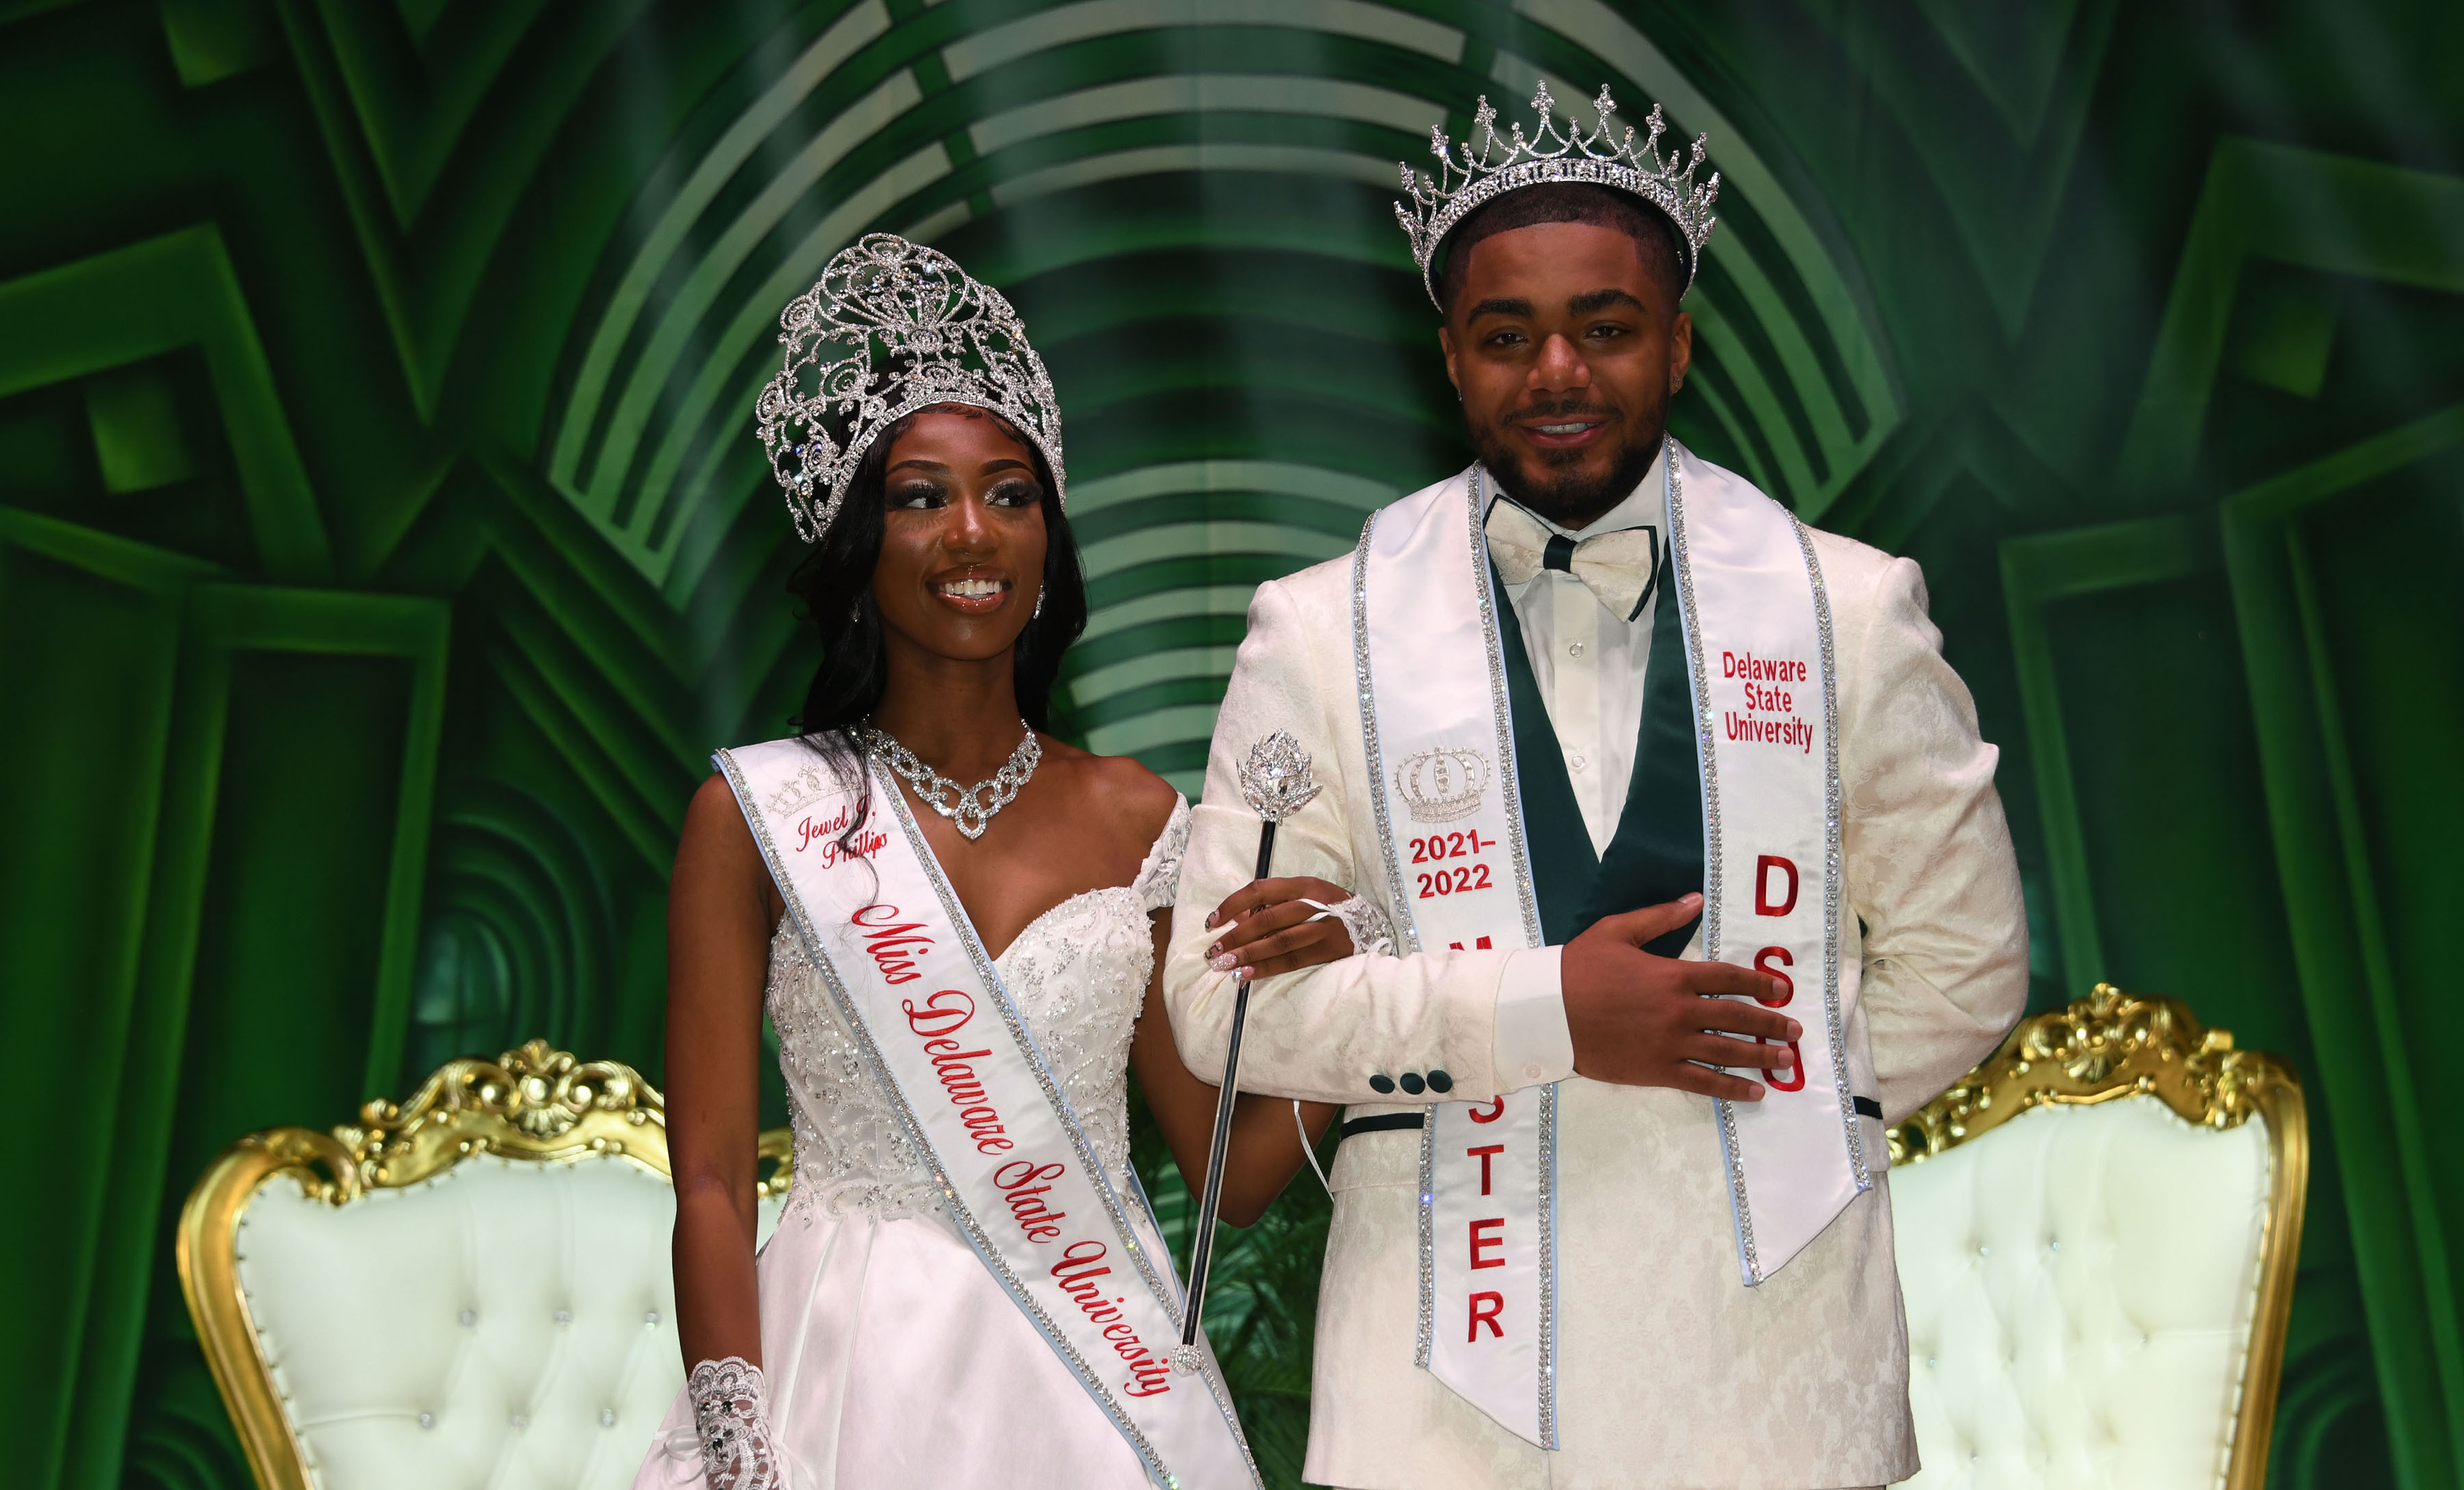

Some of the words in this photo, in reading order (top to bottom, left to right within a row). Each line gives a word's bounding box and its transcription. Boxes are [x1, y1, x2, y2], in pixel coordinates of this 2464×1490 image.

[1722, 650, 1807, 682] Delaware
[1745, 682, 1793, 713] State
[1725, 710, 1813, 754] University
[796, 805, 849, 852] Jewel
[1409, 829, 1496, 864] 2021-
[821, 830, 888, 869] Phillips
[1416, 863, 1493, 899] 2022
[851, 904, 936, 985] Miss
[901, 990, 1014, 1155] Delaware
[993, 1161, 1066, 1244] State
[1051, 1240, 1171, 1398] University
